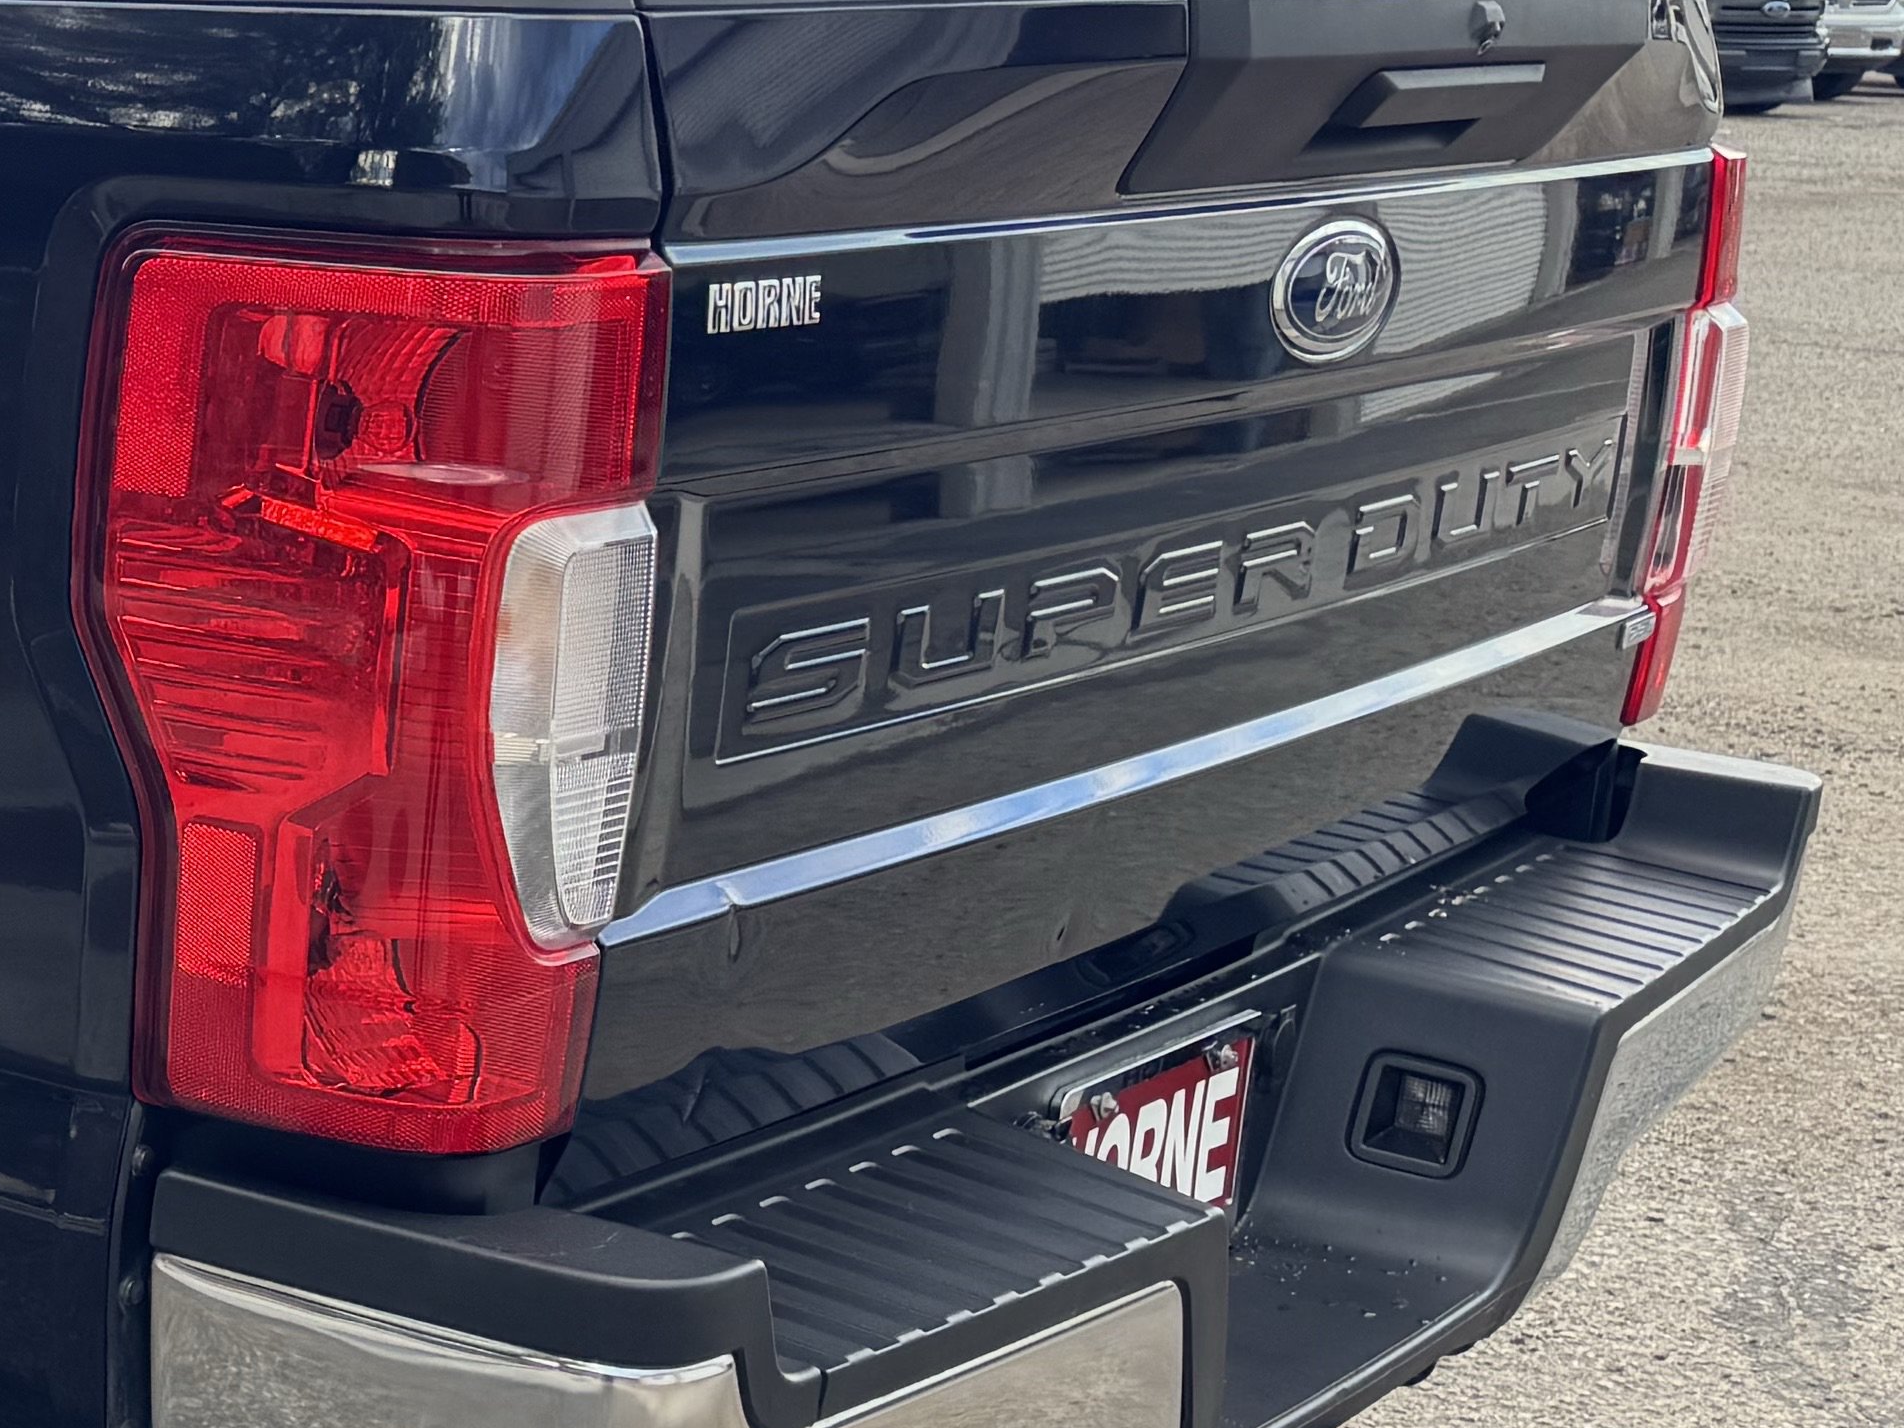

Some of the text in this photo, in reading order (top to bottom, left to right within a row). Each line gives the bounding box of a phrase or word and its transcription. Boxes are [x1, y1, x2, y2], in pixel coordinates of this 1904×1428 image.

[707, 274, 822, 334] HORNE
[1314, 249, 1380, 323] Ford
[744, 437, 1615, 724] SUPER DUTY
[1072, 1066, 1241, 1204] RNE
